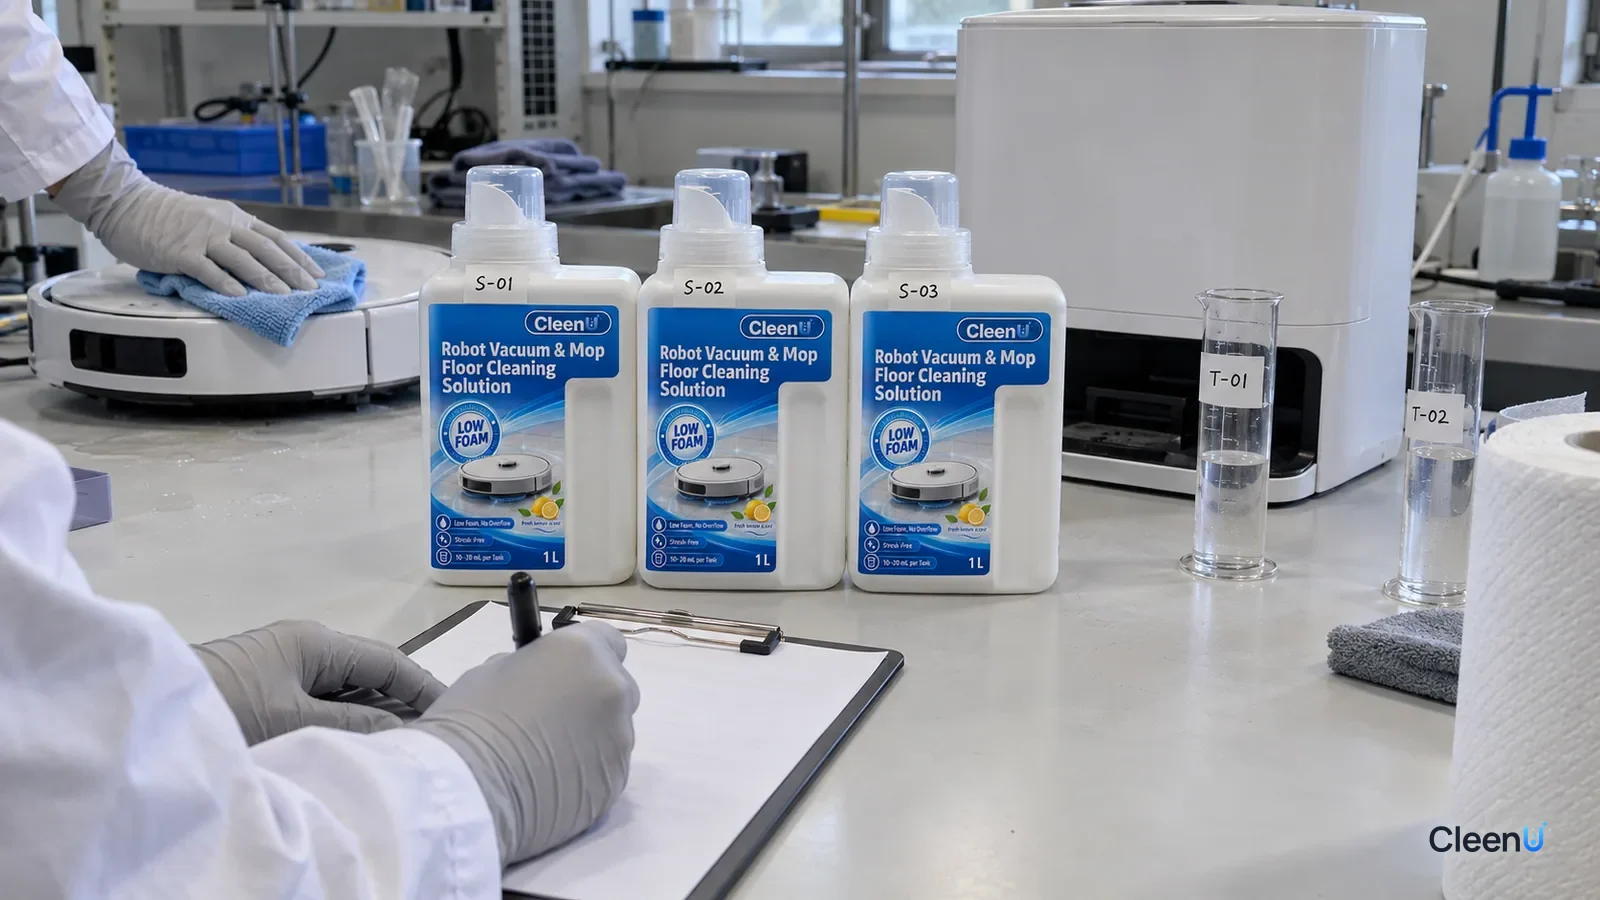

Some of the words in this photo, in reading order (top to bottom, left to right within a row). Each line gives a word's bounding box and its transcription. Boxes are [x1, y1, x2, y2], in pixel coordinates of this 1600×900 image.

[475, 275, 513, 291] S-01
[684, 280, 724, 295] S-02
[899, 283, 938, 299] S-03
[442, 341, 486, 357] Robot
[489, 342, 550, 357] Vacuum
[554, 342, 565, 357] &
[570, 342, 605, 361] Mop
[660, 345, 702, 360] Robot
[705, 346, 764, 361] Vacuum
[768, 346, 779, 362] &
[783, 347, 818, 365] Mop
[875, 349, 918, 365] Robot
[921, 349, 981, 365] Vacuum
[985, 350, 996, 365] &
[1001, 350, 1036, 369] Mop
[442, 359, 483, 375] Floor
[486, 360, 556, 379] Cleaning
[660, 363, 699, 379] Floor
[702, 364, 770, 383] Cleaning
[875, 367, 915, 383] Floor
[918, 368, 987, 387] Cleaning
[442, 378, 511, 394] Solution
[1209, 370, 1248, 389] T-01
[660, 381, 726, 398] Solution
[875, 385, 941, 402] Solution
[1412, 406, 1450, 425] T-02
[457, 419, 484, 434] LOW
[674, 422, 699, 437] LOW
[888, 427, 914, 442] LOW
[455, 432, 488, 449] FOAM
[671, 435, 703, 451] FOAM
[886, 439, 918, 455] FOAM
[543, 551, 549, 563] 1
[552, 551, 559, 563] L
[755, 554, 761, 566] 1
[764, 554, 771, 566] L
[968, 557, 974, 569] 1
[977, 557, 984, 569] L
